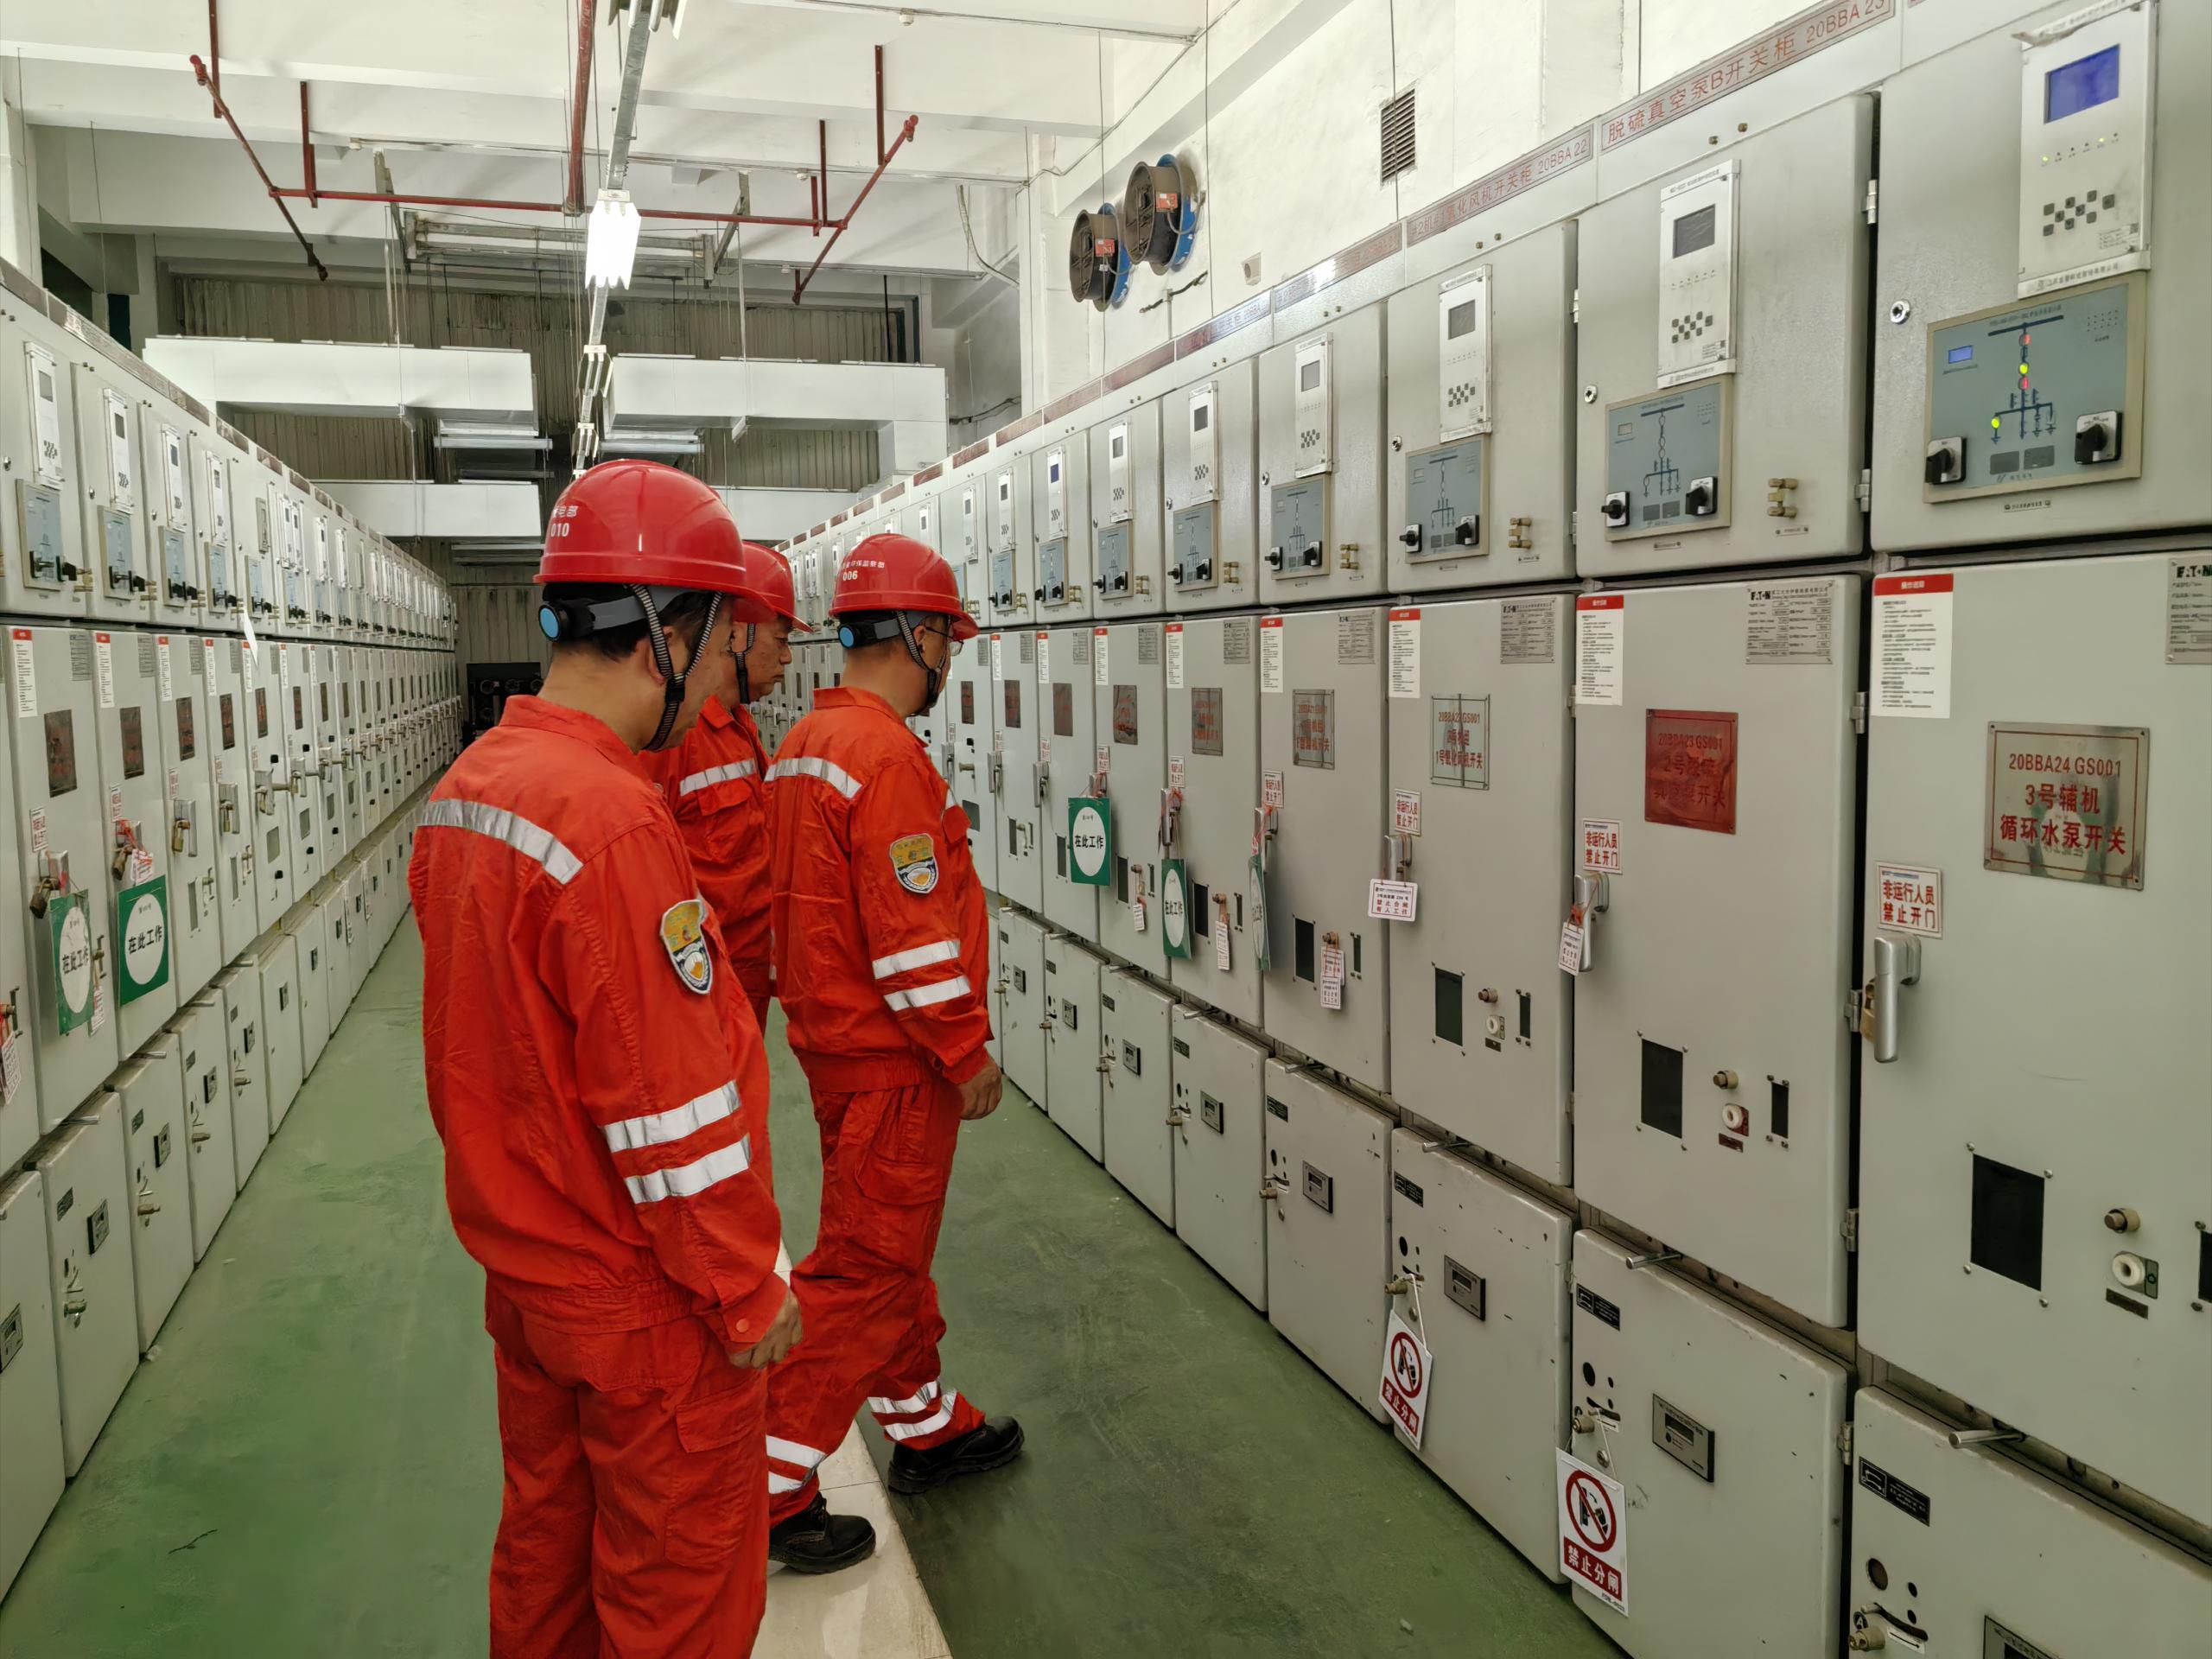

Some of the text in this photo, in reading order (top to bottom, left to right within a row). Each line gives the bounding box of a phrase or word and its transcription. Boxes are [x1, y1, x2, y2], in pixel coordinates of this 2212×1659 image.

[1607, 32, 1796, 144] 脱硫真空泵B开关柜
[1806, 3, 1860, 43] 20BBA
[1537, 149, 1572, 175] 20BBA
[1573, 141, 1587, 161] 22
[550, 522, 569, 537] 010
[842, 570, 858, 582] 006
[2009, 753, 2121, 778] 20BBA24 GS001
[2024, 783, 2101, 814] 3号辅机
[1074, 835, 1104, 849] 在此工作
[1586, 830, 1618, 849] 非运行人员
[2000, 814, 2126, 855] 循环水泵开关
[1586, 849, 1618, 867] 禁止开门
[1883, 880, 1935, 906] 非运行人员
[1165, 900, 1183, 915] 在此工作
[1884, 901, 1936, 929] 禁止开门
[128, 925, 162, 954] 在此工作
[1384, 1382, 1417, 1433] 禁止分闸
[1567, 1544, 1619, 1596] 禁止分闸
